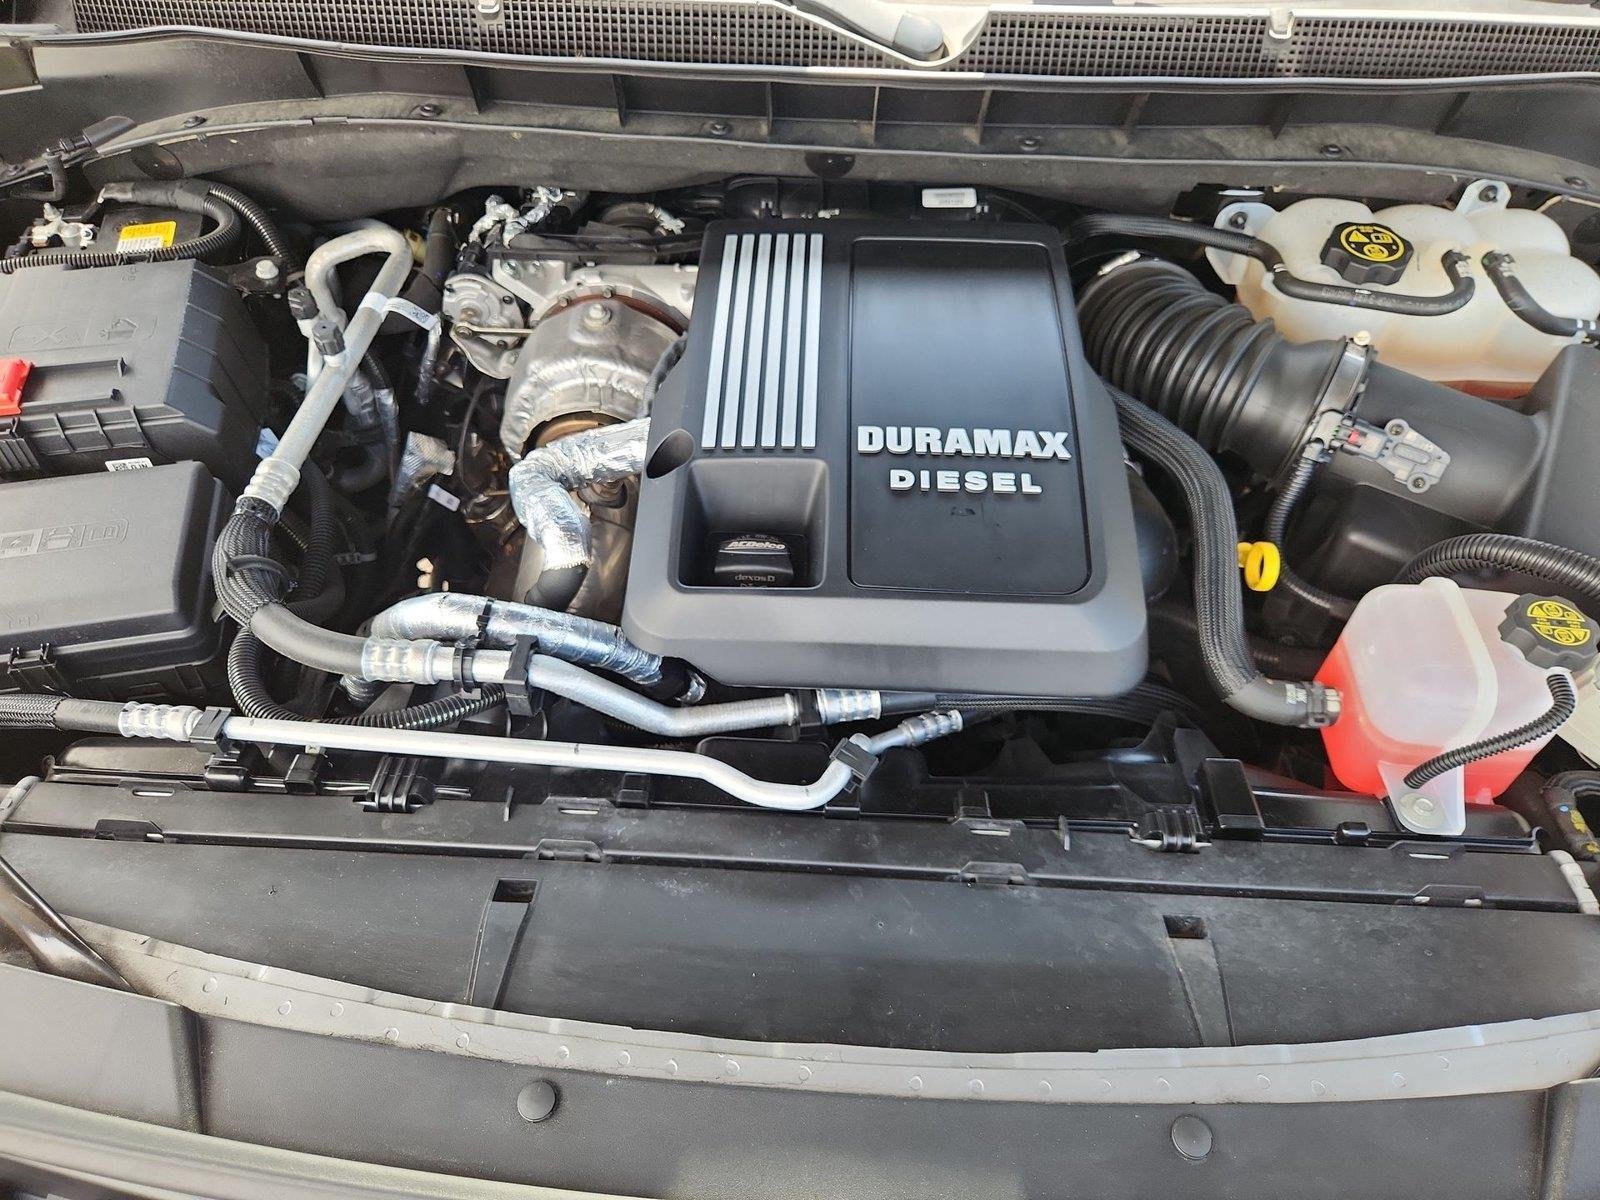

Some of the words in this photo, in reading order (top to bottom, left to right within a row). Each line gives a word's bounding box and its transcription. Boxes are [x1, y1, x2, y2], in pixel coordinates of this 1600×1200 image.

[856, 425, 1072, 462] DURAMAX
[889, 469, 1043, 495] DIESEL
[727, 540, 786, 551] ACDelco
